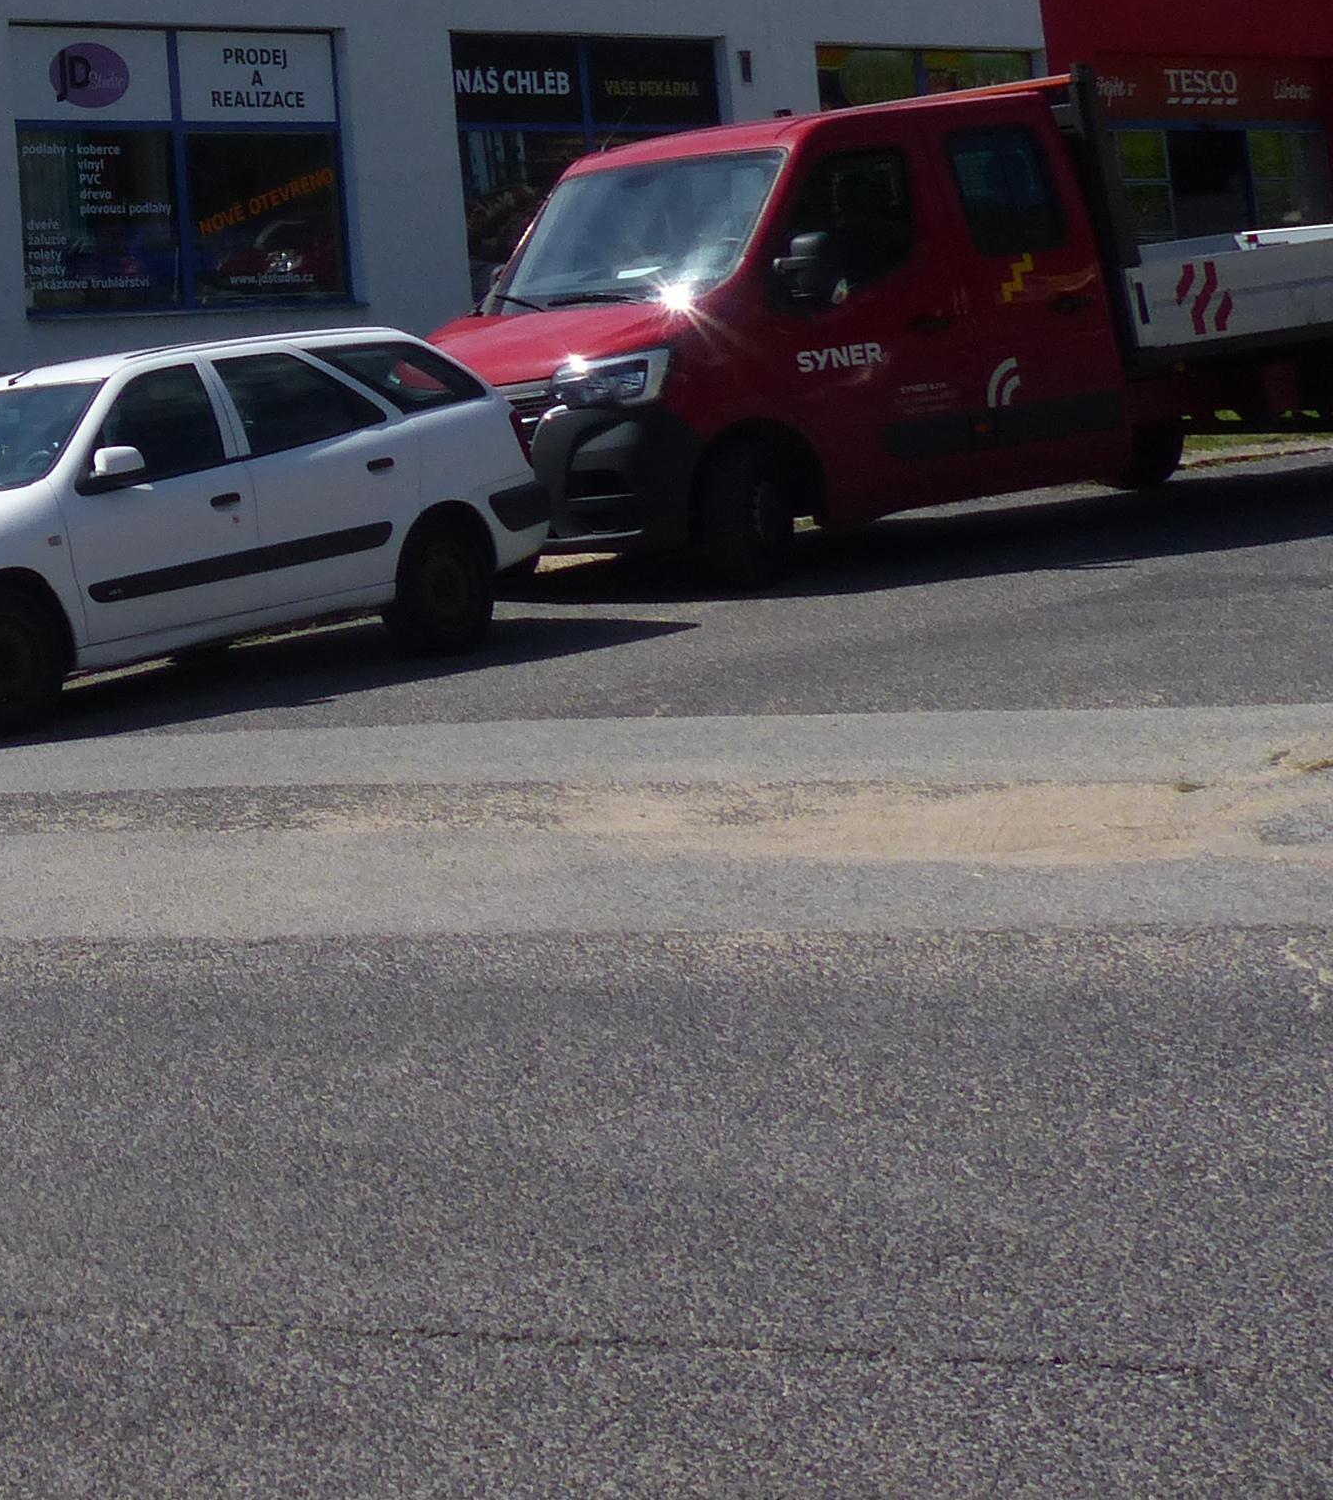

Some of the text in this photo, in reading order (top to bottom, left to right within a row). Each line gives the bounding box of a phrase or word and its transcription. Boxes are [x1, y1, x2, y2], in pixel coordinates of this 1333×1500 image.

[223, 48, 289, 69] PRODEJ
[252, 70, 263, 87] A
[454, 66, 571, 95] NÁŠ CHLÉB
[1163, 68, 1238, 94] TESCO
[211, 90, 306, 109] REALIZACE
[21, 143, 68, 158] podlahy
[76, 142, 121, 156] koberce
[76, 158, 105, 172] vinyl
[79, 173, 102, 186] PVC
[129, 200, 172, 217] podlahy
[27, 248, 63, 262] rolety
[28, 264, 67, 278] tapety
[228, 272, 315, 286] www.jdstudio.cz
[795, 341, 883, 374] SYNER
